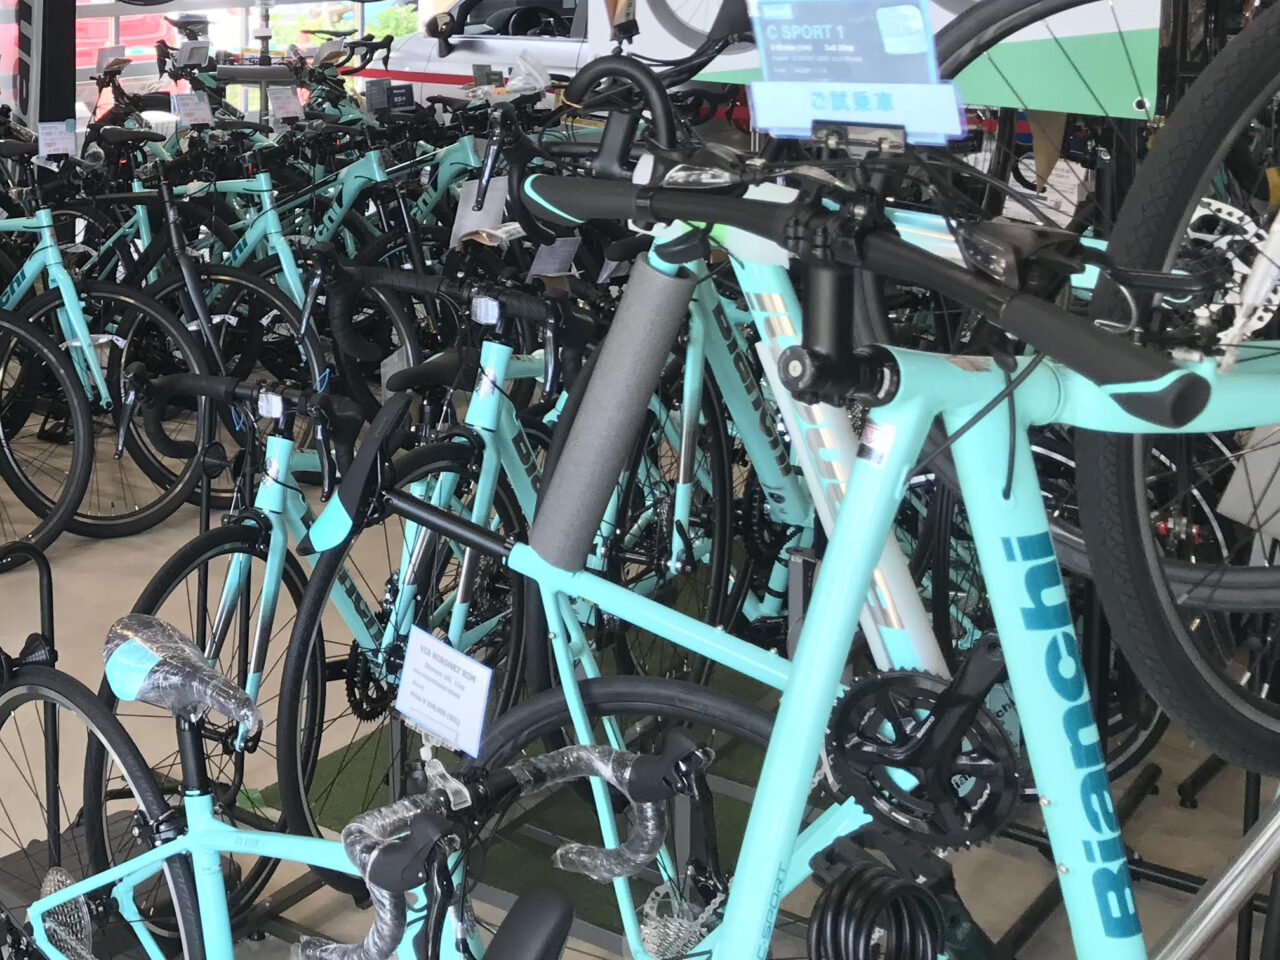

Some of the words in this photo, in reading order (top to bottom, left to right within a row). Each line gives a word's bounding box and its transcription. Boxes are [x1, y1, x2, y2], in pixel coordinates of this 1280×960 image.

[766, 25, 778, 39] C
[780, 24, 832, 39] SPORT
[836, 26, 844, 39] 1
[810, 90, 894, 112] ご試乗車
[1000, 531, 1141, 940] Bianchi
